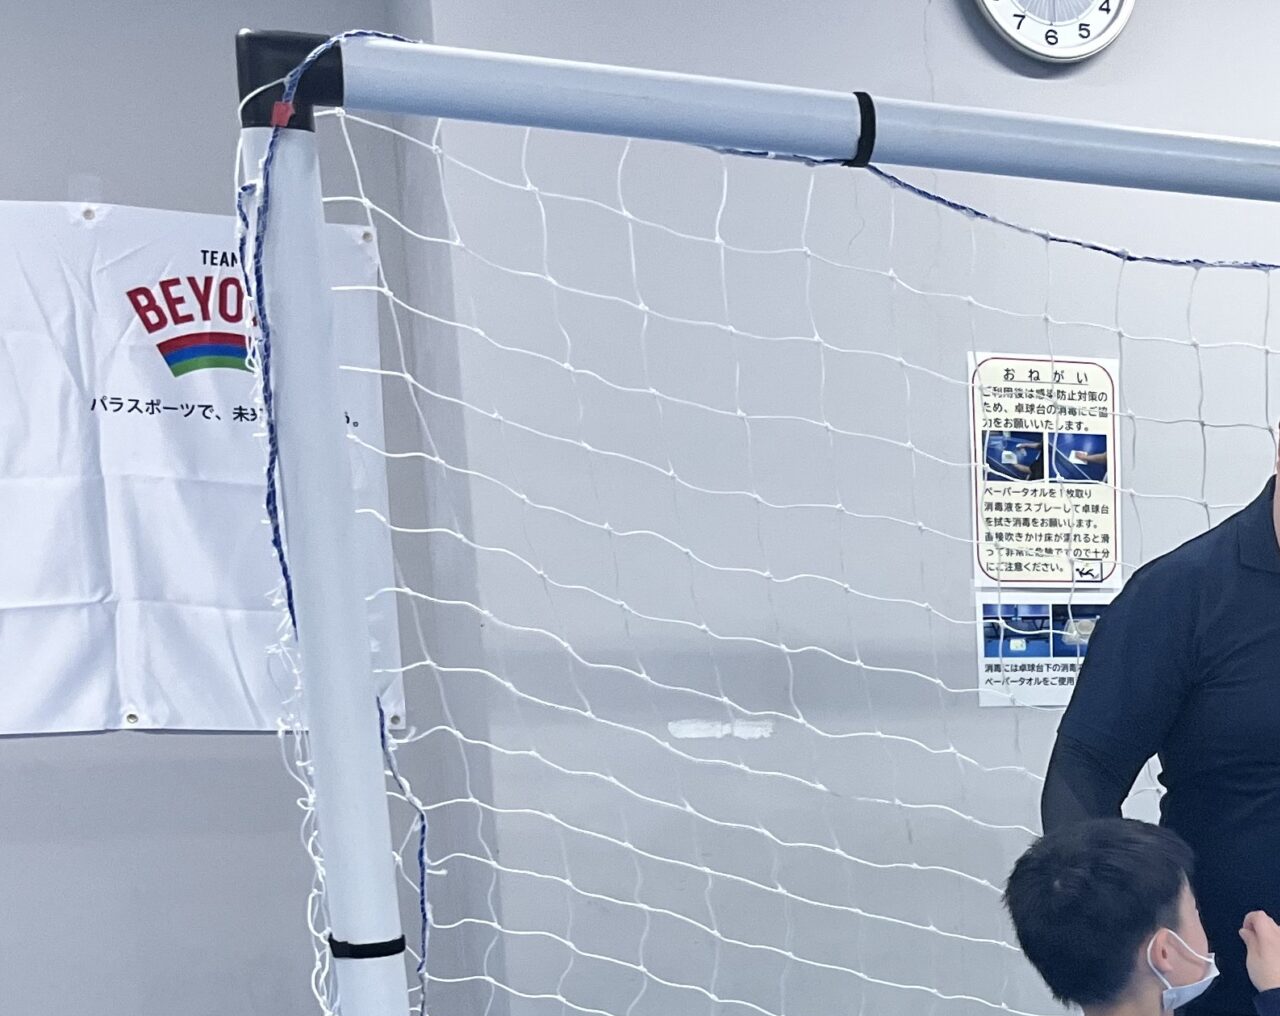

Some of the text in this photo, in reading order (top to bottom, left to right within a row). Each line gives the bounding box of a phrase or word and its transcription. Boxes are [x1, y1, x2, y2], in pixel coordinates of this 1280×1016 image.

[1013, 14, 1025, 30] 7
[1045, 29, 1059, 46] 6
[1078, 23, 1091, 39] 5
[126, 275, 258, 335] BEYO
[985, 663, 1082, 674] 消毒には卓球台下の消毒
